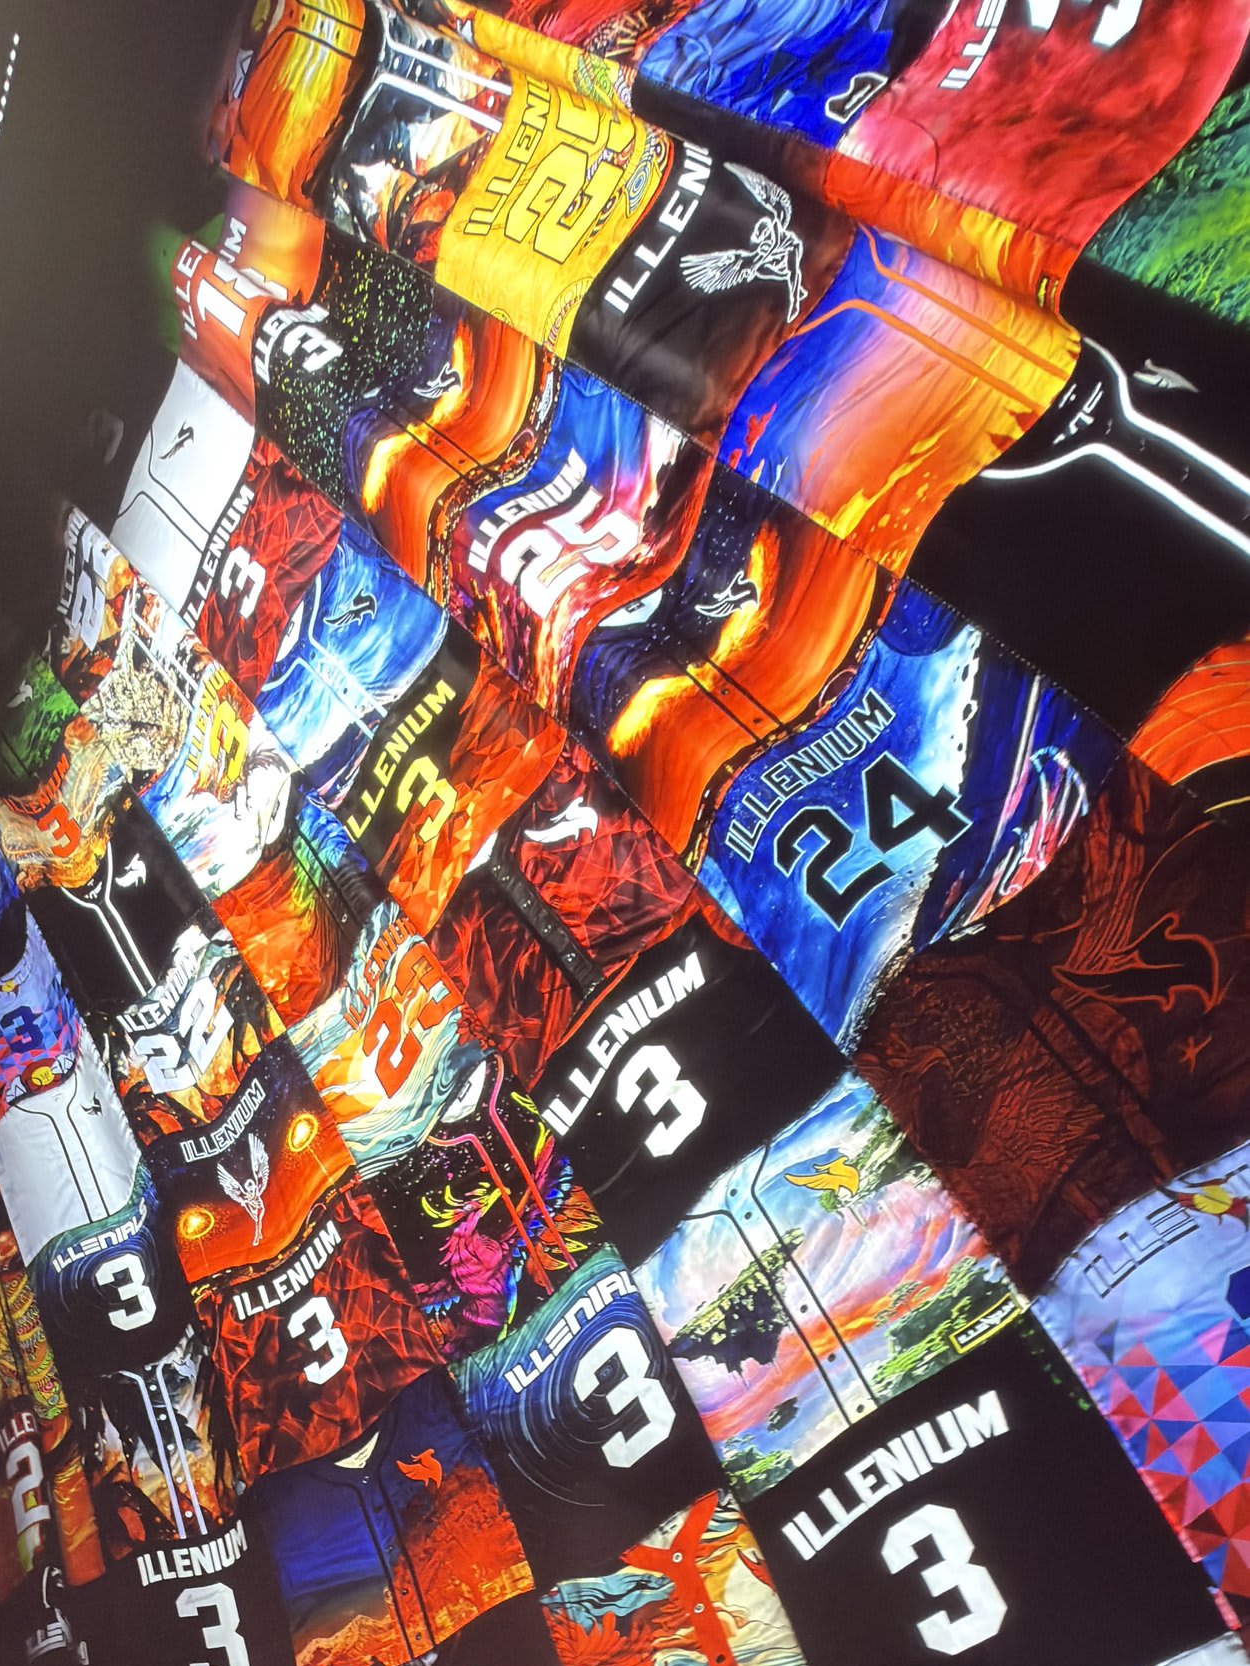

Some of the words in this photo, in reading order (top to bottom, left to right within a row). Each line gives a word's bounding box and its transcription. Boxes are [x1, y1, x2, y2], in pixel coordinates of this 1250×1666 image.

[282, 326, 342, 372] 3
[182, 485, 255, 630] ILLENIUM
[466, 449, 587, 573] ILLENIUM
[500, 489, 641, 616] 25
[221, 546, 266, 620] 3
[6, 752, 68, 818] ILLENIUM
[210, 701, 250, 783] 3
[726, 688, 895, 862] ILLENIUM
[36, 804, 81, 859] 3
[398, 756, 458, 843] 3
[773, 751, 973, 931] 24
[0, 1005, 44, 1051] 3
[116, 952, 197, 1033] ILLENIUM
[136, 977, 234, 1094] 22
[362, 943, 464, 1099] 23
[542, 951, 706, 1136] ILLENIUM
[180, 1079, 266, 1163] ILLENIUM
[616, 1046, 707, 1157] 3
[95, 1254, 156, 1331] 3
[232, 1220, 342, 1321] ILLENIUM
[288, 1297, 349, 1385] 3
[573, 1327, 676, 1468] 3
[6, 1441, 50, 1535] 2
[781, 1390, 1010, 1560] ILLENIUM
[137, 1520, 247, 1587] ILLENIUM
[880, 1503, 1008, 1656] 3
